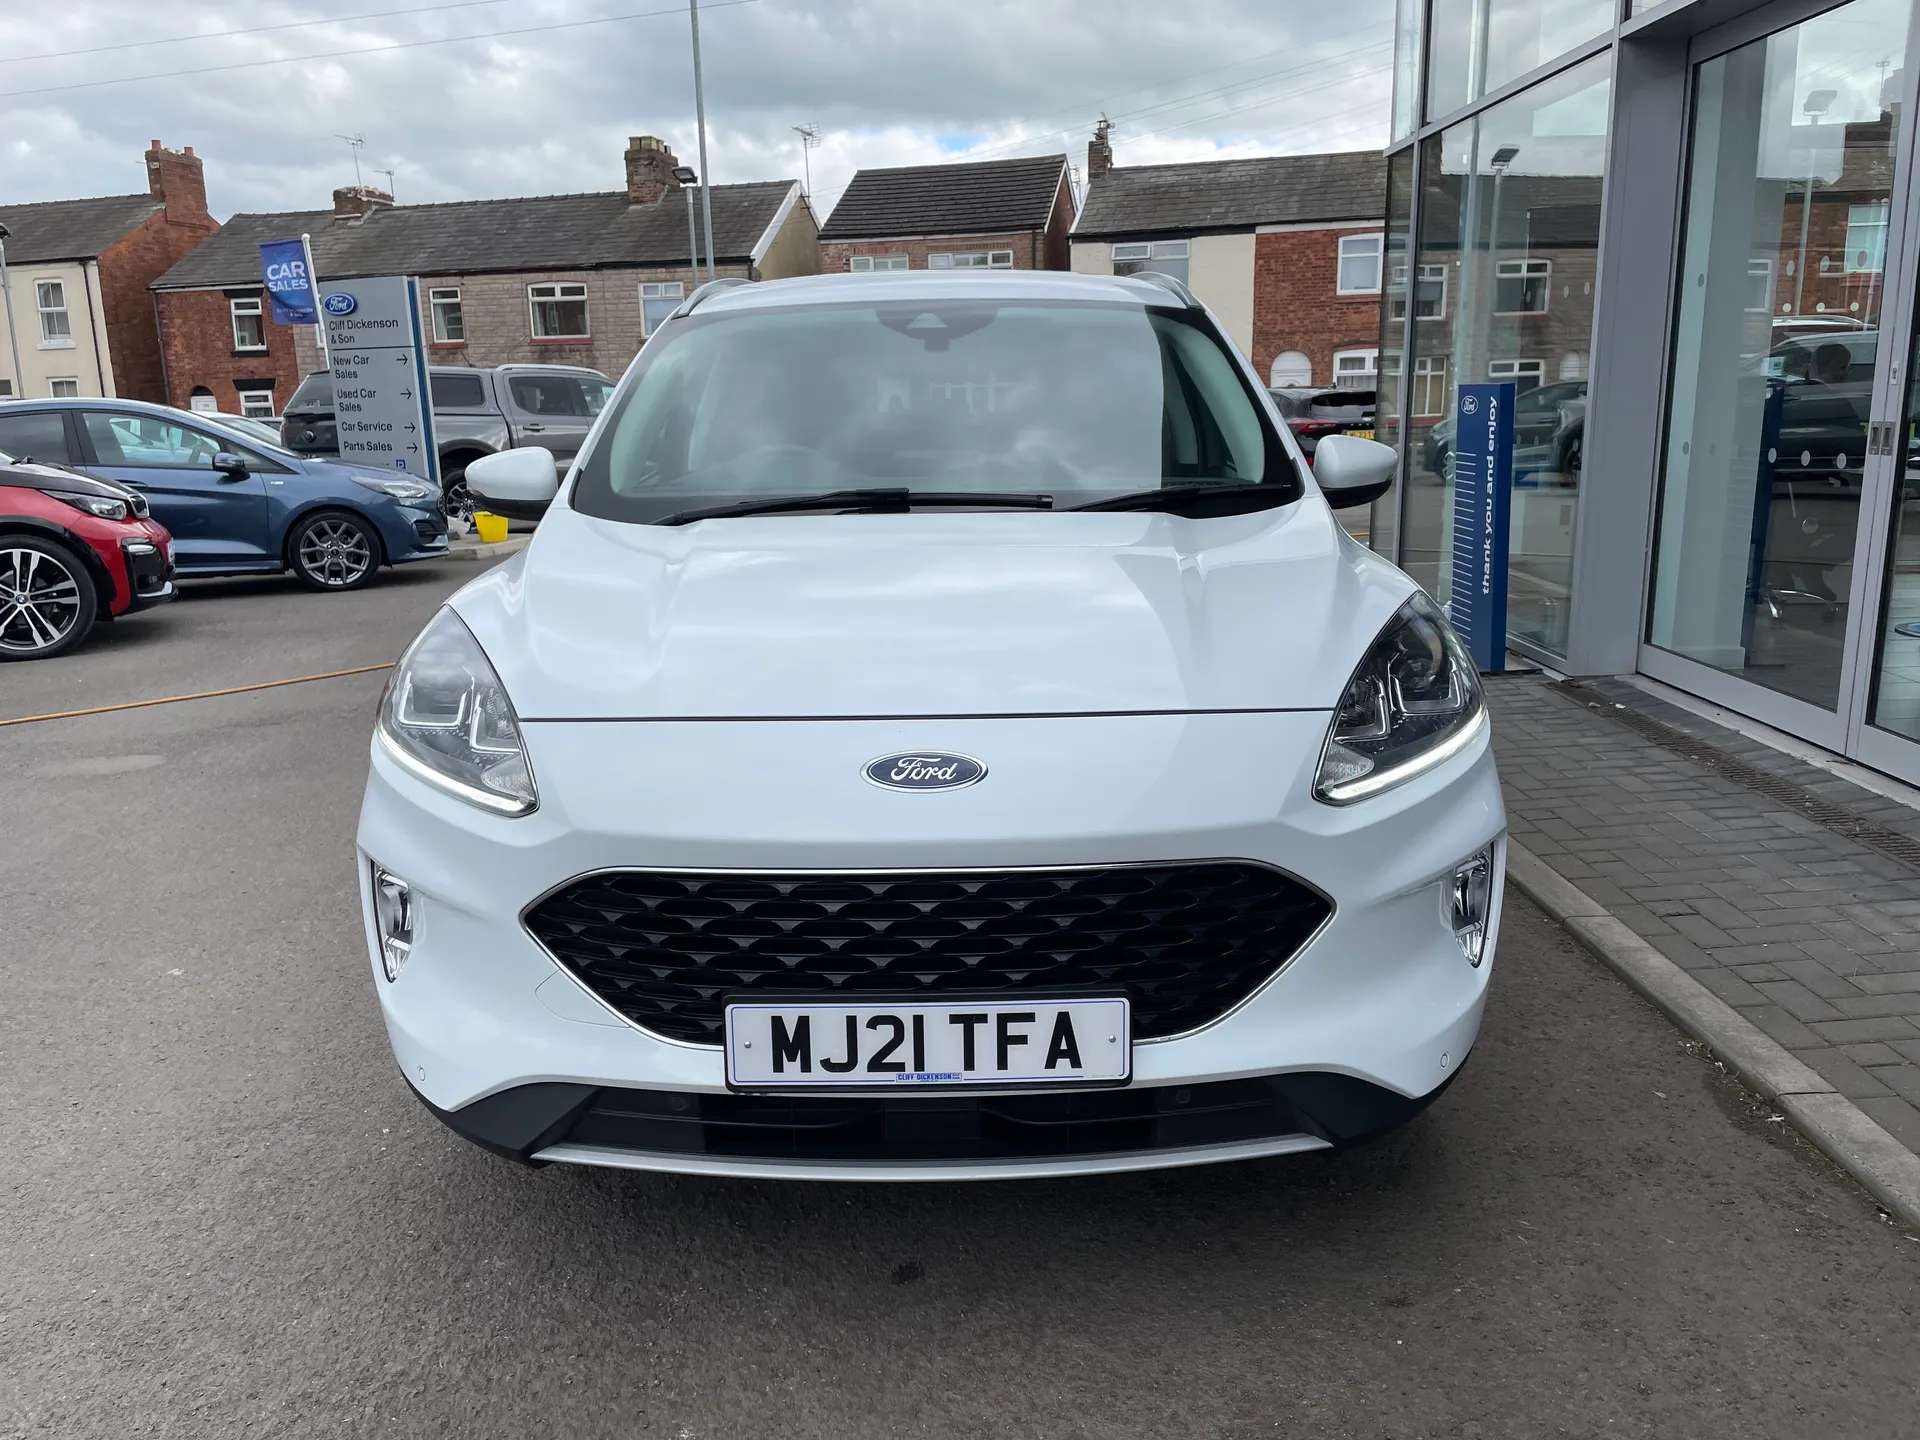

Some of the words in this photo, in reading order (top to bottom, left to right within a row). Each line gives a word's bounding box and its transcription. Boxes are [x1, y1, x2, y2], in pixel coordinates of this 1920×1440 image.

[267, 261, 306, 280] CAR
[268, 279, 309, 292] SALES
[329, 320, 345, 331] Cliff
[347, 319, 399, 330] Dickenson
[331, 334, 337, 344] &
[338, 334, 355, 344] Son
[333, 356, 351, 366] New
[353, 355, 370, 365] Car
[335, 369, 358, 379] Sales
[337, 388, 359, 399] Used
[360, 388, 377, 399] Car
[339, 402, 362, 412] Sales
[341, 421, 356, 432] Car
[357, 421, 393, 432] Service
[1487, 396, 1497, 452] enjoy
[343, 441, 365, 451] Parts
[367, 441, 393, 451] Sales
[1486, 455, 1494, 495] and
[1485, 498, 1493, 534] you
[1482, 538, 1491, 595] thank
[890, 757, 958, 781] Ford
[770, 1014, 926, 1073] MJ21
[948, 1010, 1083, 1072] TFA
[897, 1073, 914, 1081] CLIFF
